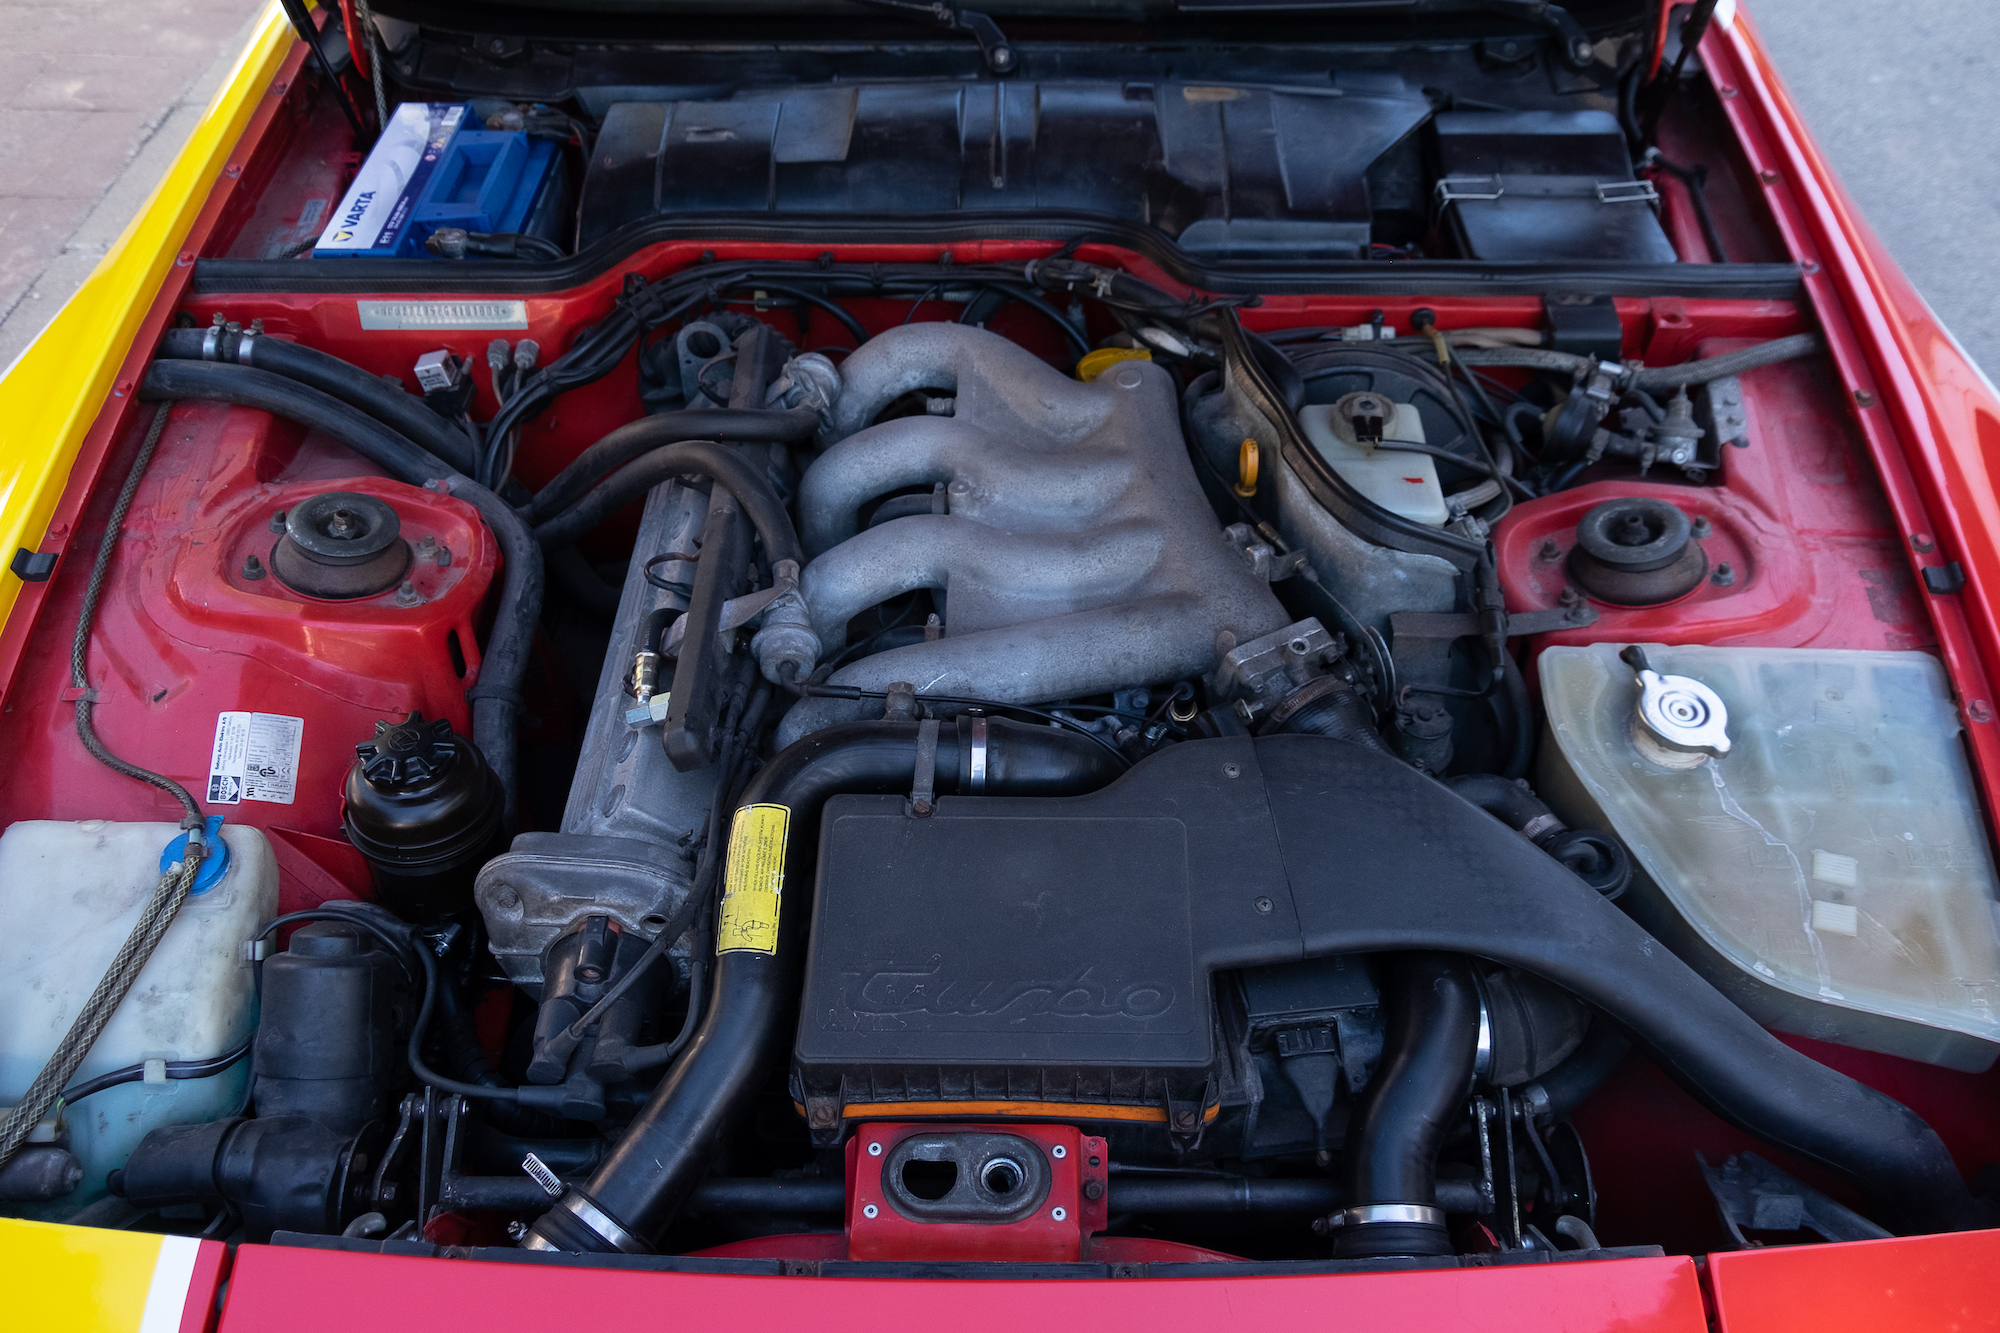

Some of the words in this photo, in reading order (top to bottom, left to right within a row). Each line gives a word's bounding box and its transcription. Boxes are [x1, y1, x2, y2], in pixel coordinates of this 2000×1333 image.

[341, 190, 376, 228] VARTA
[380, 231, 394, 244] E11
[259, 766, 276, 777] GS
[220, 777, 229, 799] BOSCH
